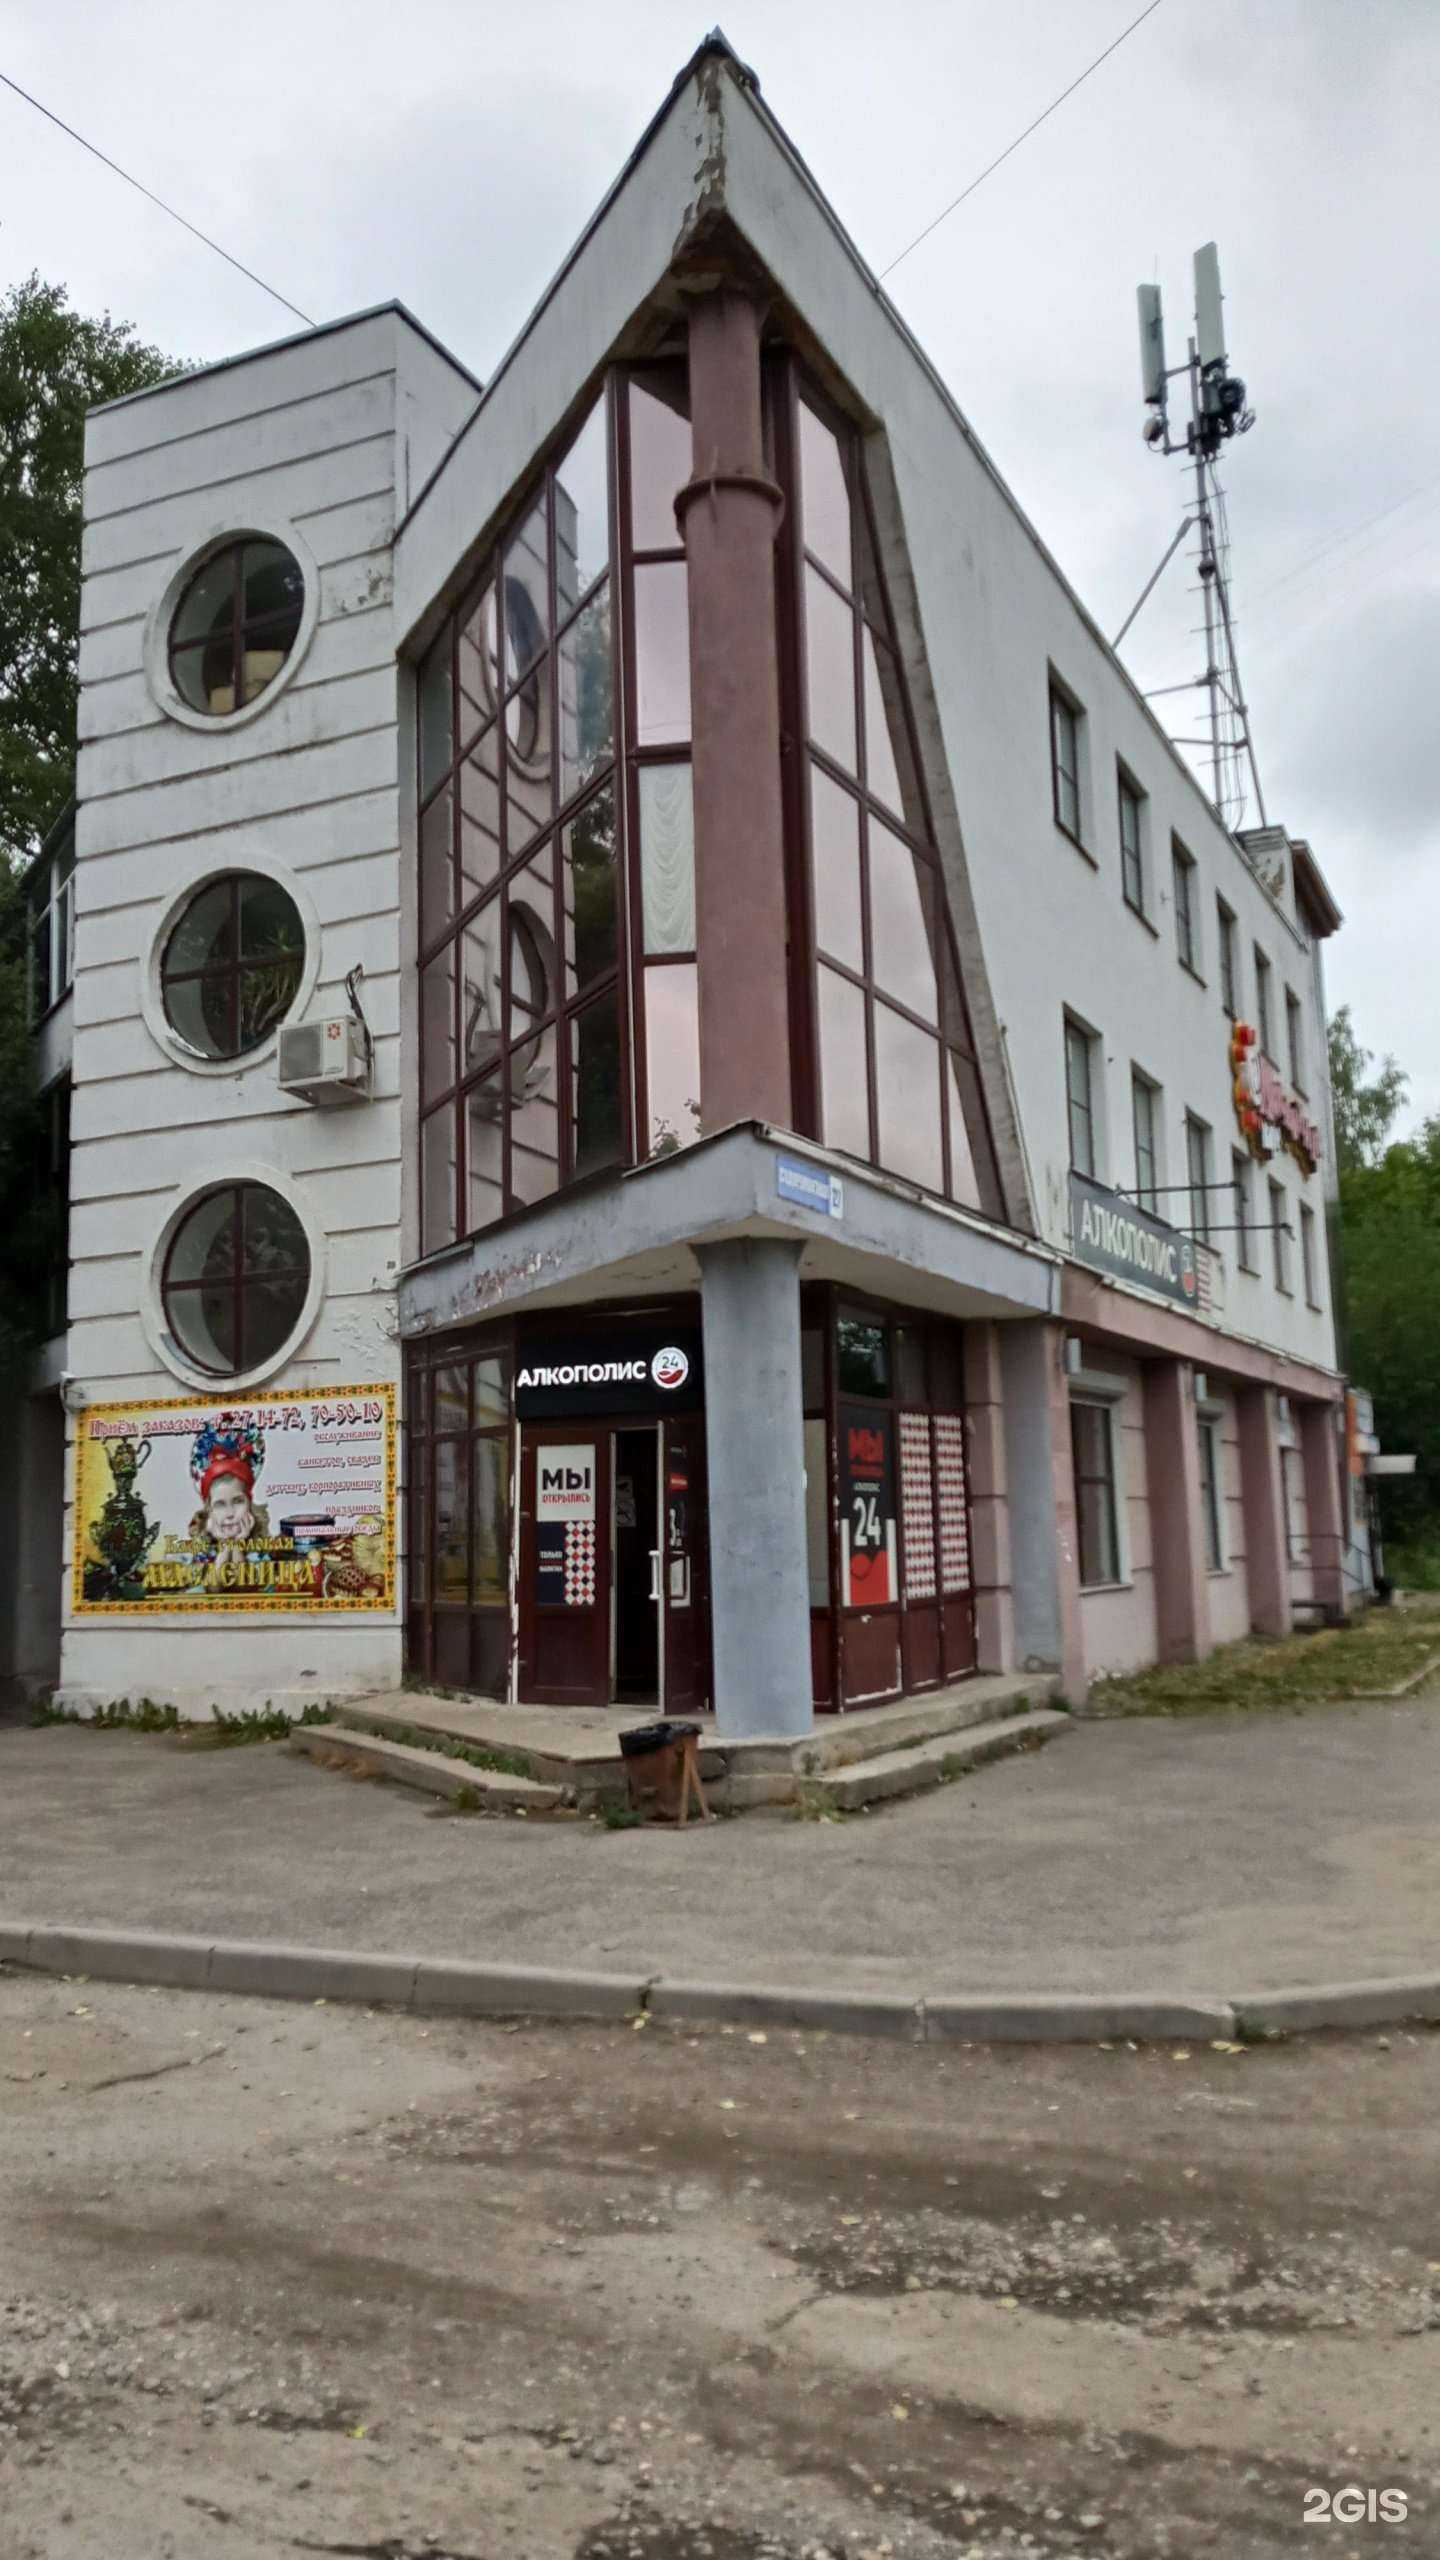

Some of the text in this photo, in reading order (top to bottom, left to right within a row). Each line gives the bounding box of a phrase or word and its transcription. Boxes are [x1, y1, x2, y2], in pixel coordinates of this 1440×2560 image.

[1079, 1199, 1178, 1284] АЛКОПОЛИС
[516, 1356, 679, 1388] АЛКОПОЛИС 24
[311, 1401, 383, 1428] 70-50-10
[542, 1467, 591, 1491] МЫ
[542, 1493, 591, 1505] ОТКРЫЛИСЬ
[853, 1497, 881, 1546] 24
